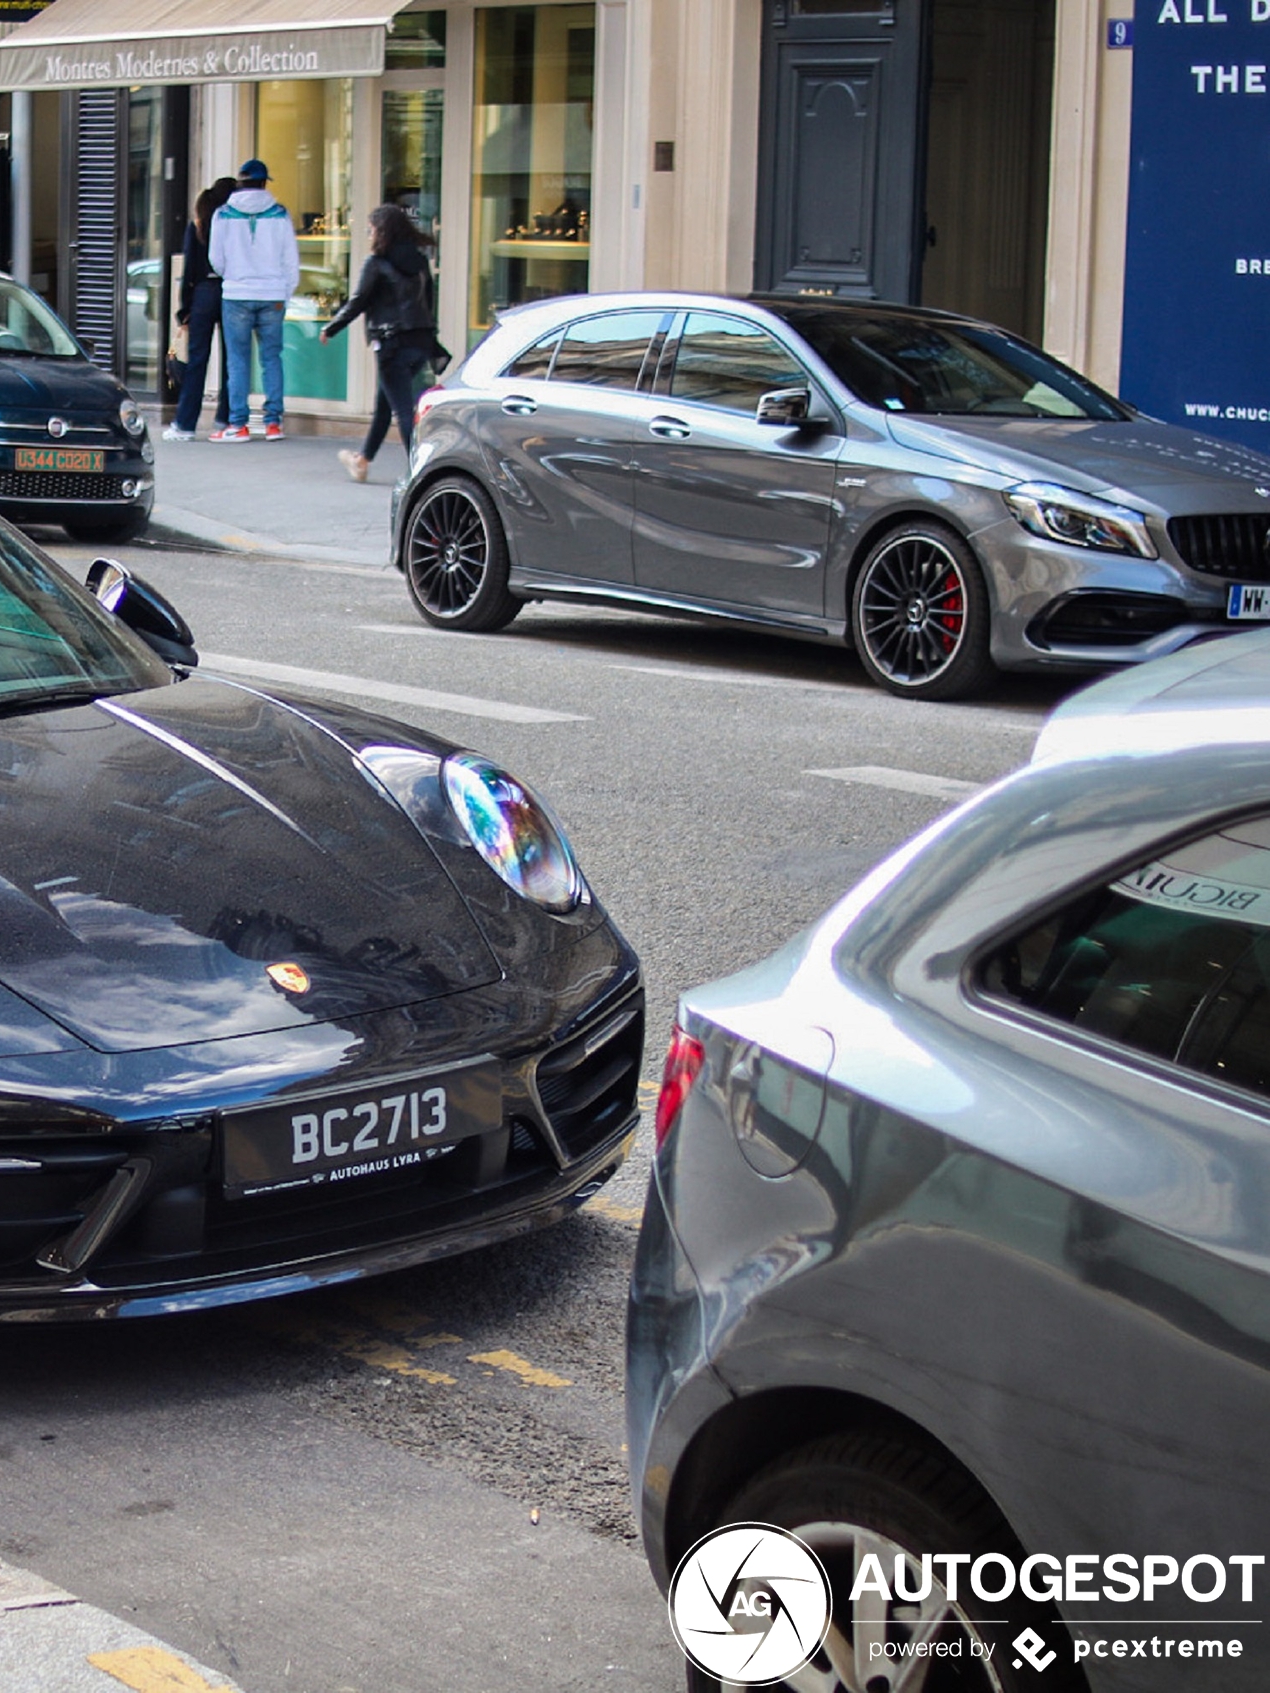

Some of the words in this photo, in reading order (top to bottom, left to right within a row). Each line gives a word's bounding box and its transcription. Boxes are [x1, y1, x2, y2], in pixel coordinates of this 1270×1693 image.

[1157, 0, 1228, 23] ALL
[1115, 22, 1127, 44] 9
[45, 56, 111, 81] Montres
[115, 50, 198, 79] Modernes
[203, 50, 221, 75] &
[224, 45, 319, 74] Collection
[1191, 65, 1266, 93] THE
[292, 1087, 447, 1164] BC2713
[329, 1158, 390, 1181] AUTOHAUS
[393, 1152, 421, 1168] LYRA
